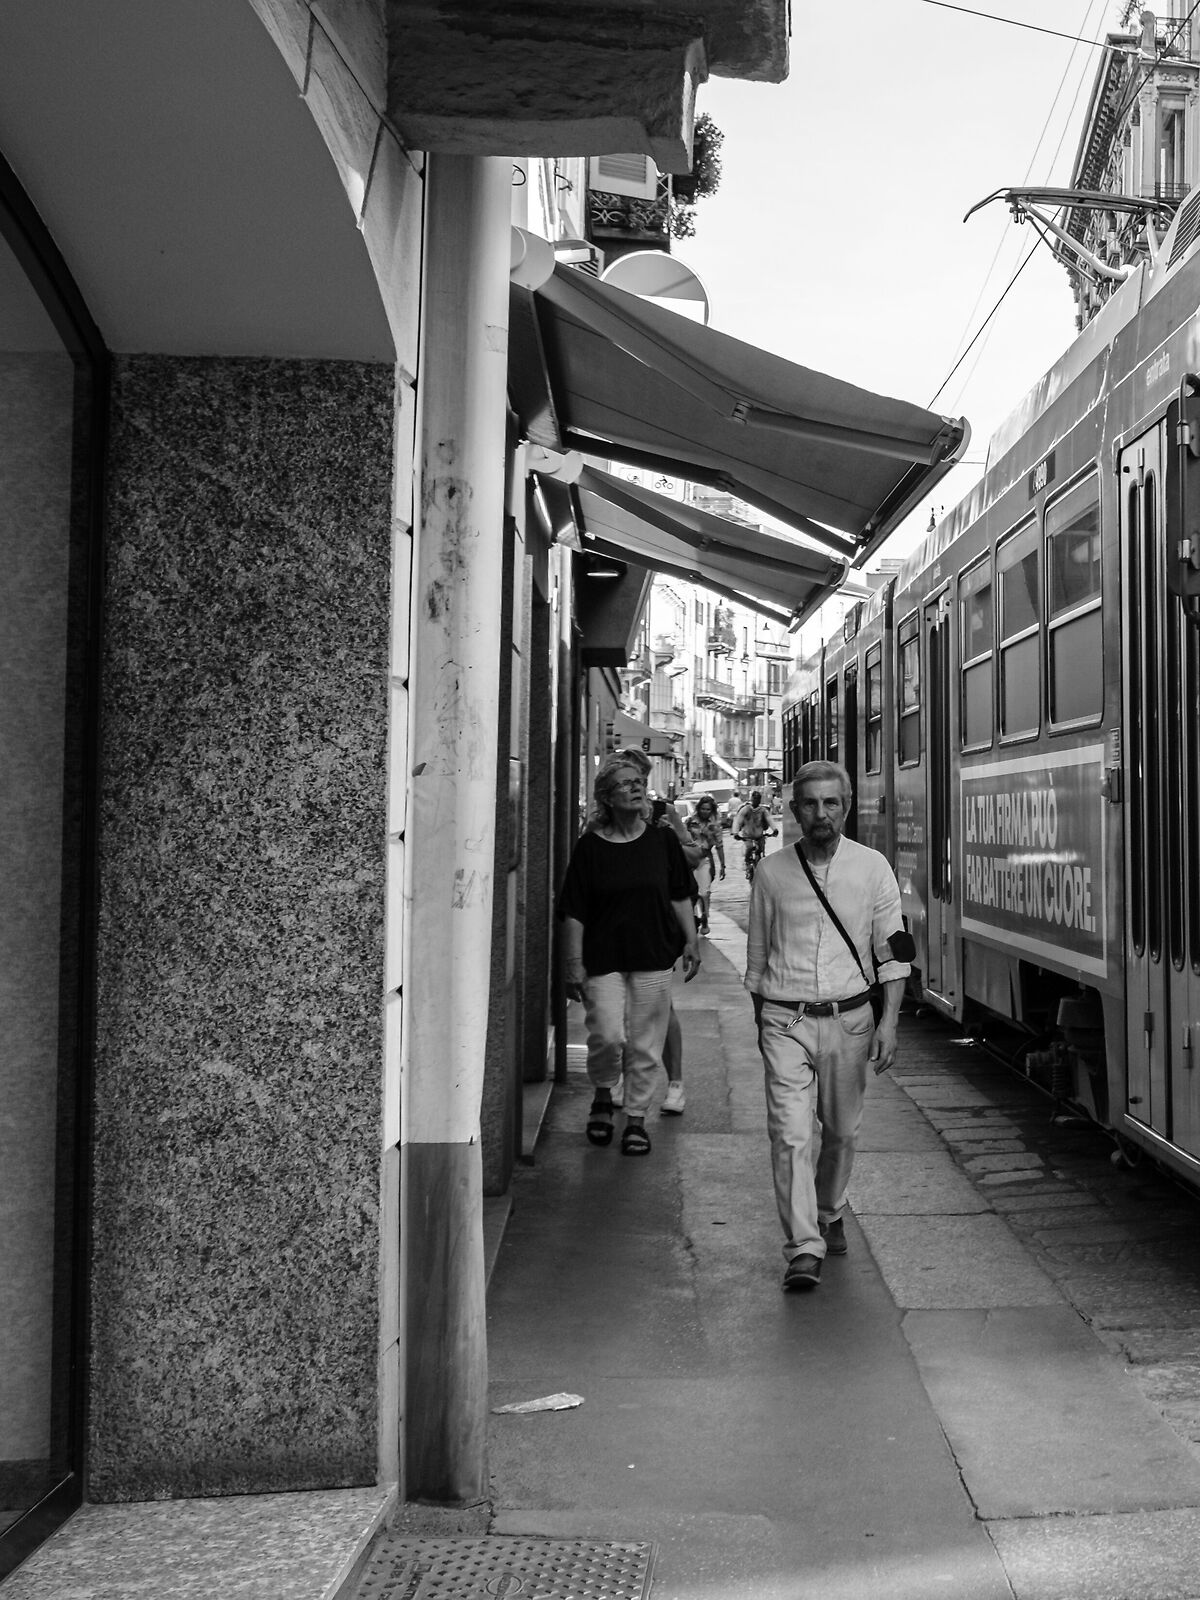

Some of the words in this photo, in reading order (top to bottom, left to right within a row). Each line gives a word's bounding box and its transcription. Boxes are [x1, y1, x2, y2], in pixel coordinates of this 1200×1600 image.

[966, 796, 977, 843] LA
[978, 795, 995, 844] TUA
[996, 791, 1030, 846] FIRMA
[966, 854, 982, 904] FAR
[983, 856, 1024, 914] BATTERE
[1025, 862, 1042, 919] UN
[1044, 862, 1096, 933] CUORE.
